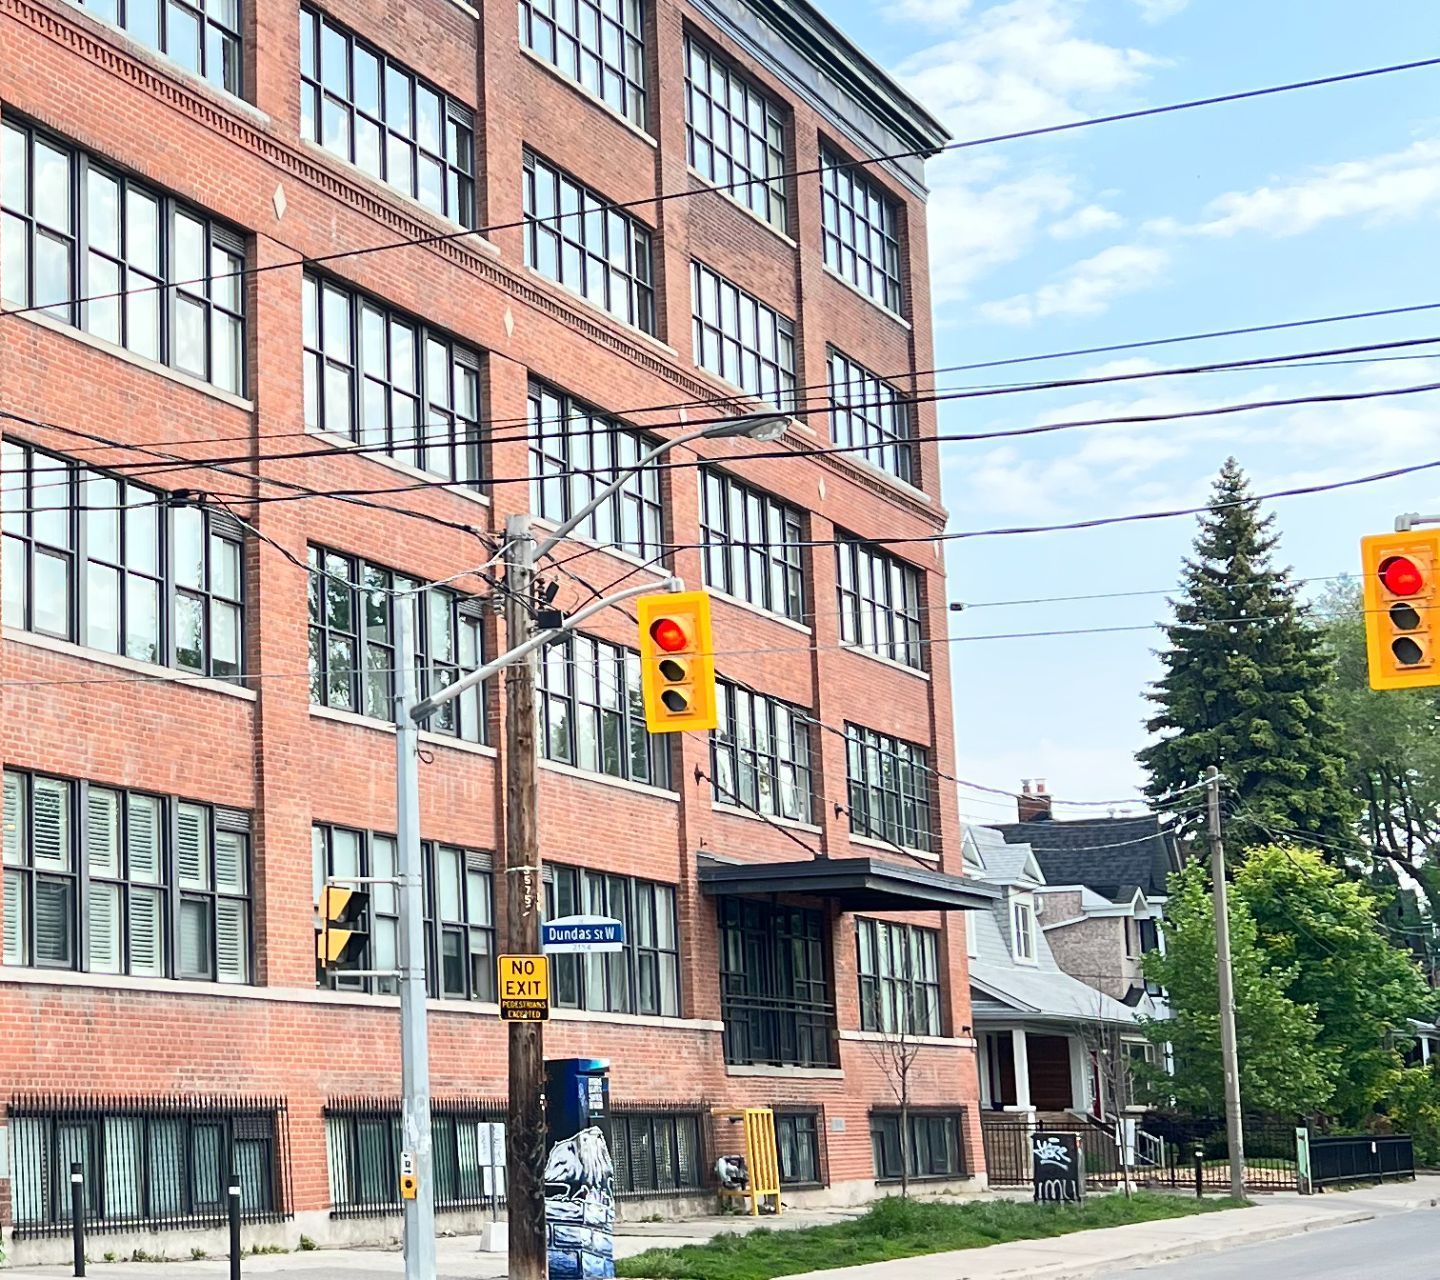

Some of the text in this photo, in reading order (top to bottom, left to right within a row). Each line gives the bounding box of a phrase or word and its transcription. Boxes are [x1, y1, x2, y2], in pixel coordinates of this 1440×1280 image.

[549, 926, 615, 941] Dundas St W
[512, 960, 535, 976] NO
[506, 980, 542, 996] EXIT
